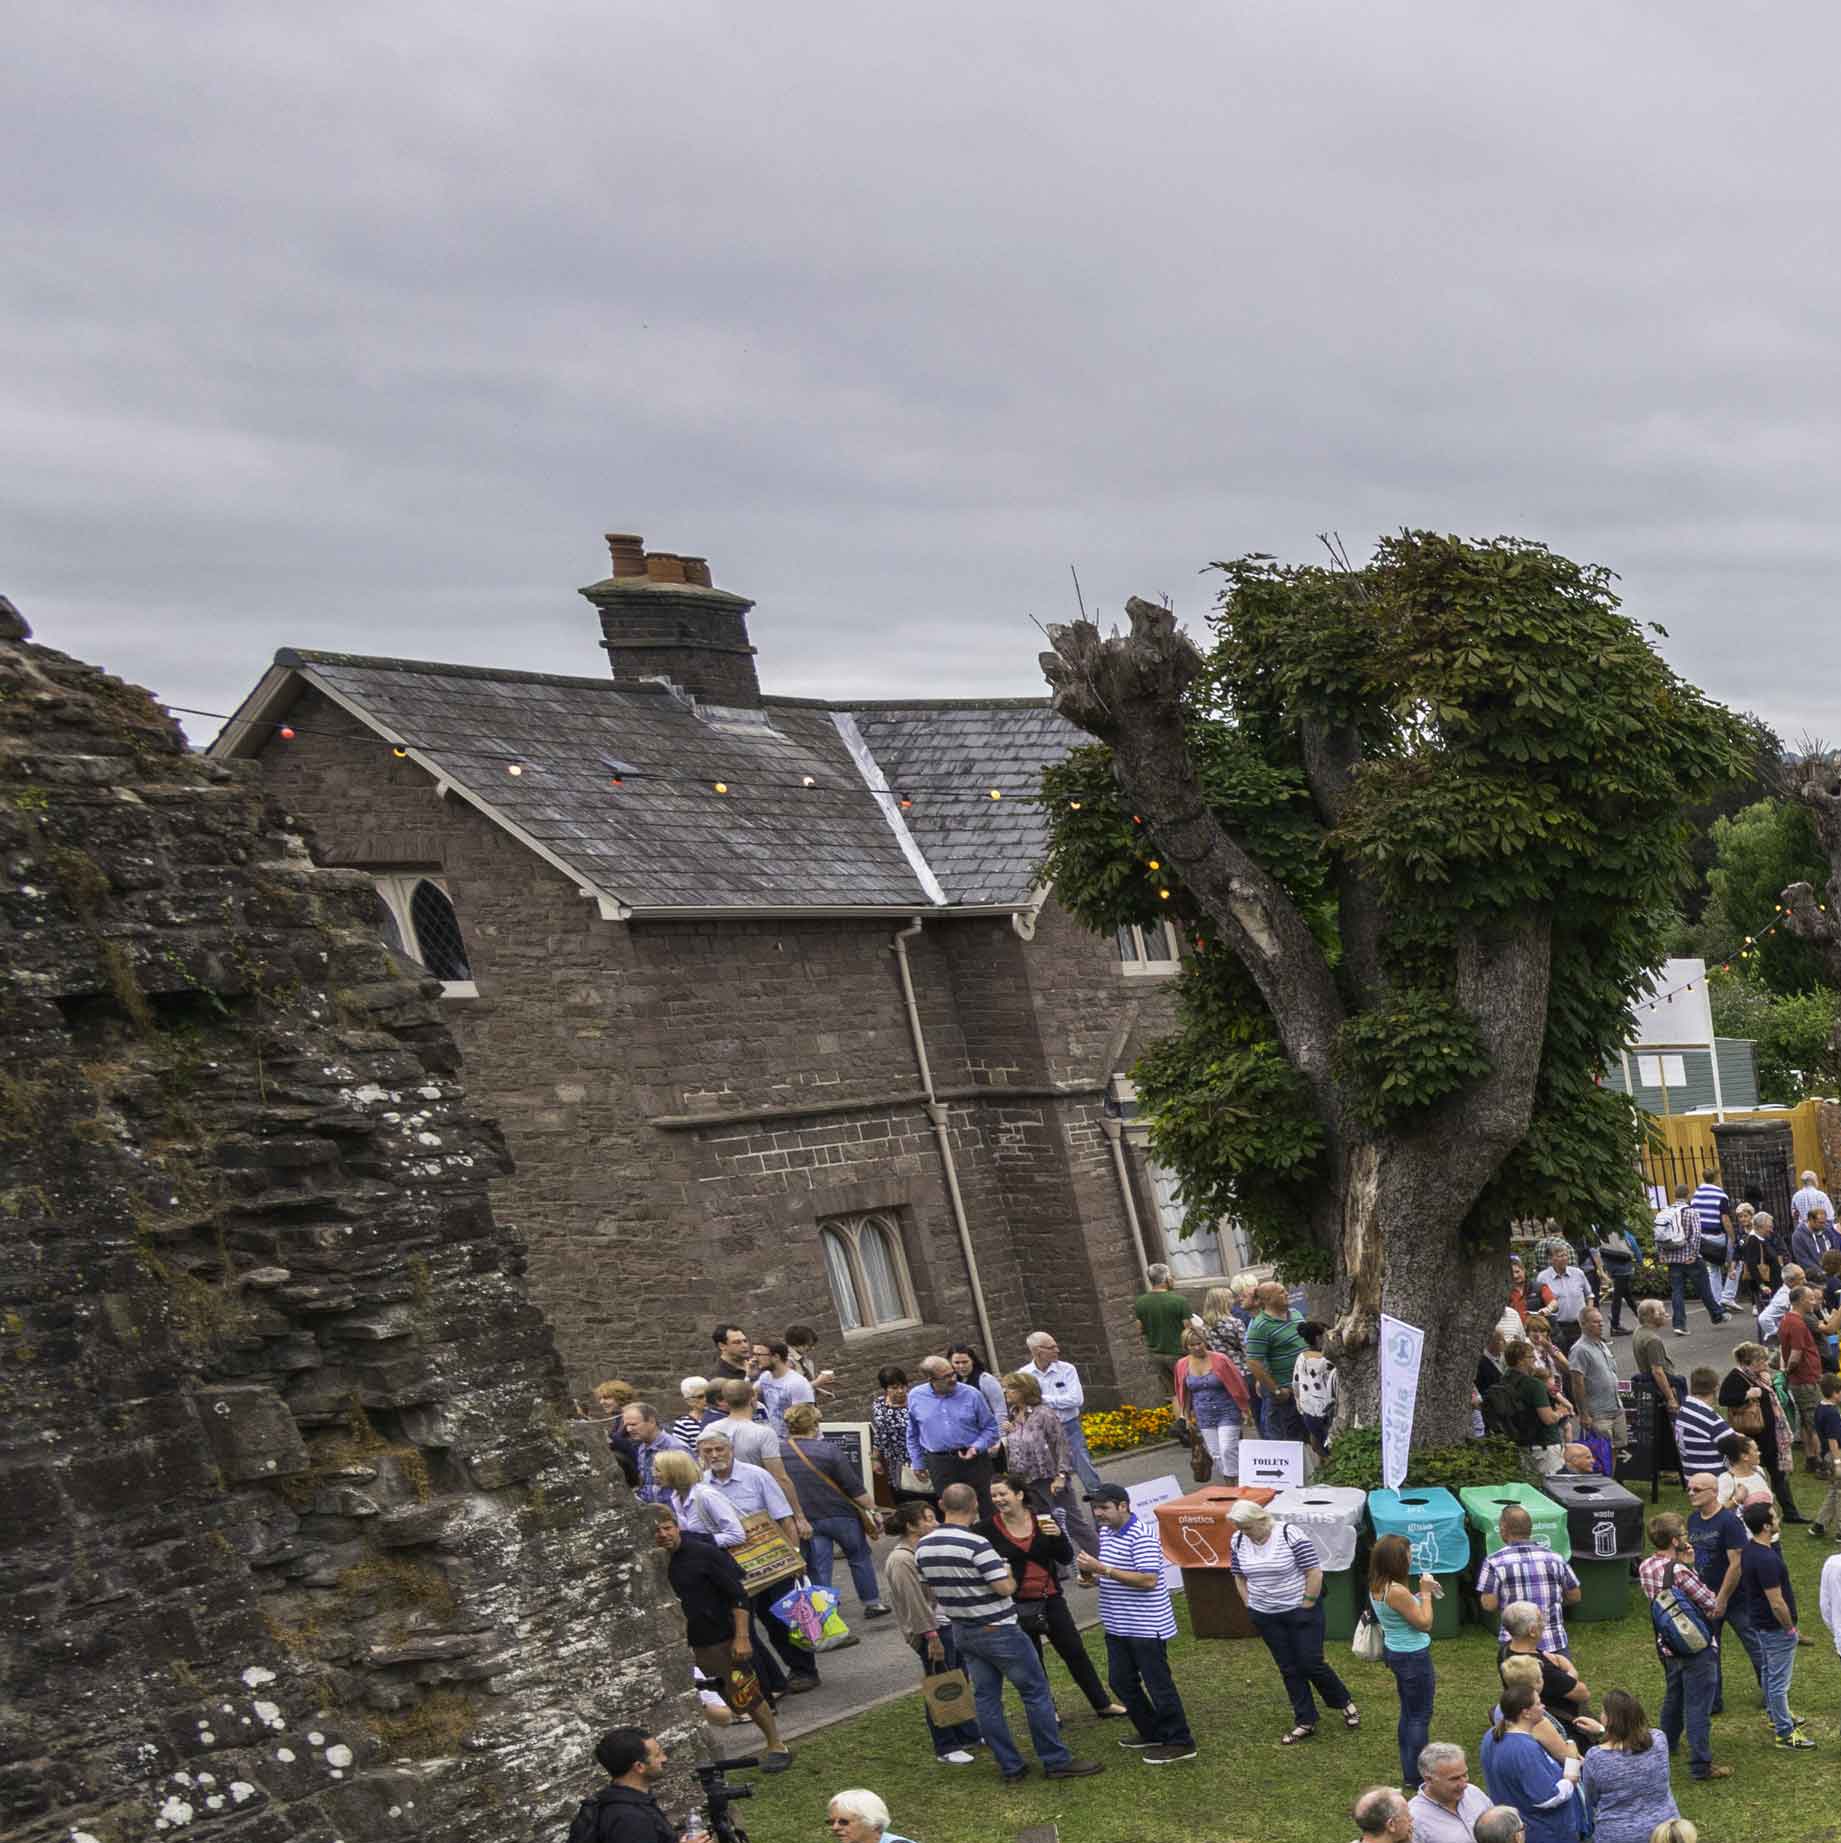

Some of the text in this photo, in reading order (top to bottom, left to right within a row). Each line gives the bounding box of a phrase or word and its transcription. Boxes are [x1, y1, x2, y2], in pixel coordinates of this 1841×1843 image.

[1252, 1457, 1289, 1466] TOILETS
[1592, 1510, 1615, 1518] waste
[1178, 1514, 1215, 1525] plastics
